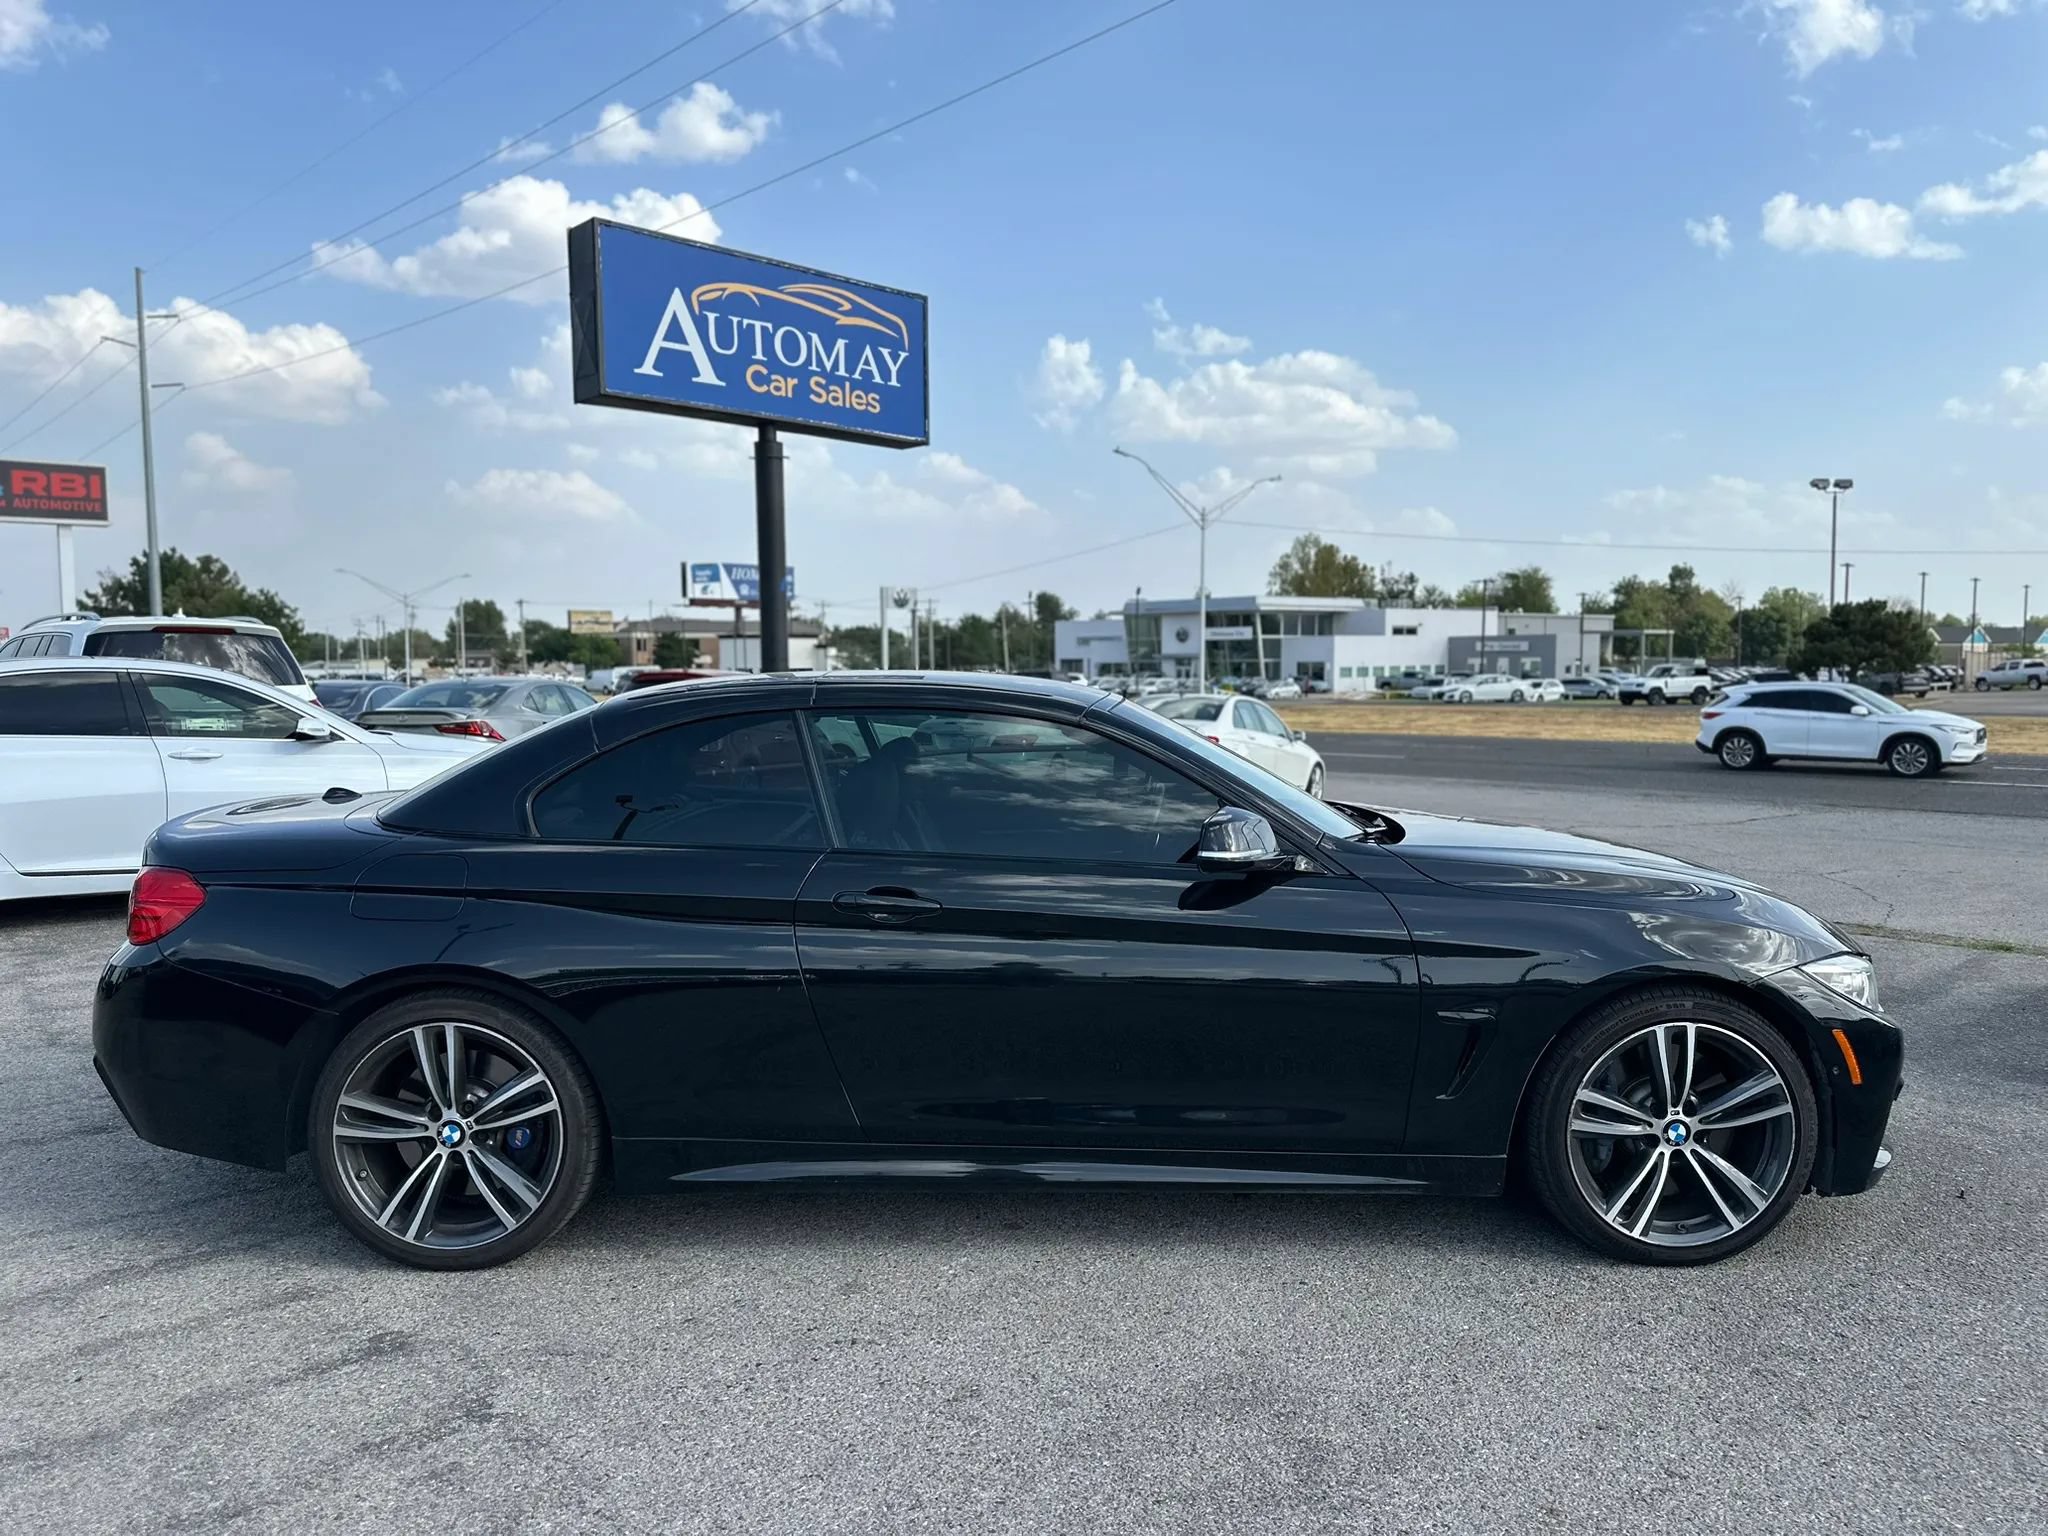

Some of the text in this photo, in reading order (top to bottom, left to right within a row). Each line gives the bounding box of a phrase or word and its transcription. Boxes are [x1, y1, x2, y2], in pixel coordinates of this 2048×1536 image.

[633, 286, 909, 388] AUTOMAY
[745, 364, 881, 414] Car Sales
[11, 469, 102, 499] RBI
[13, 497, 102, 512] AUTOMOTIVE
